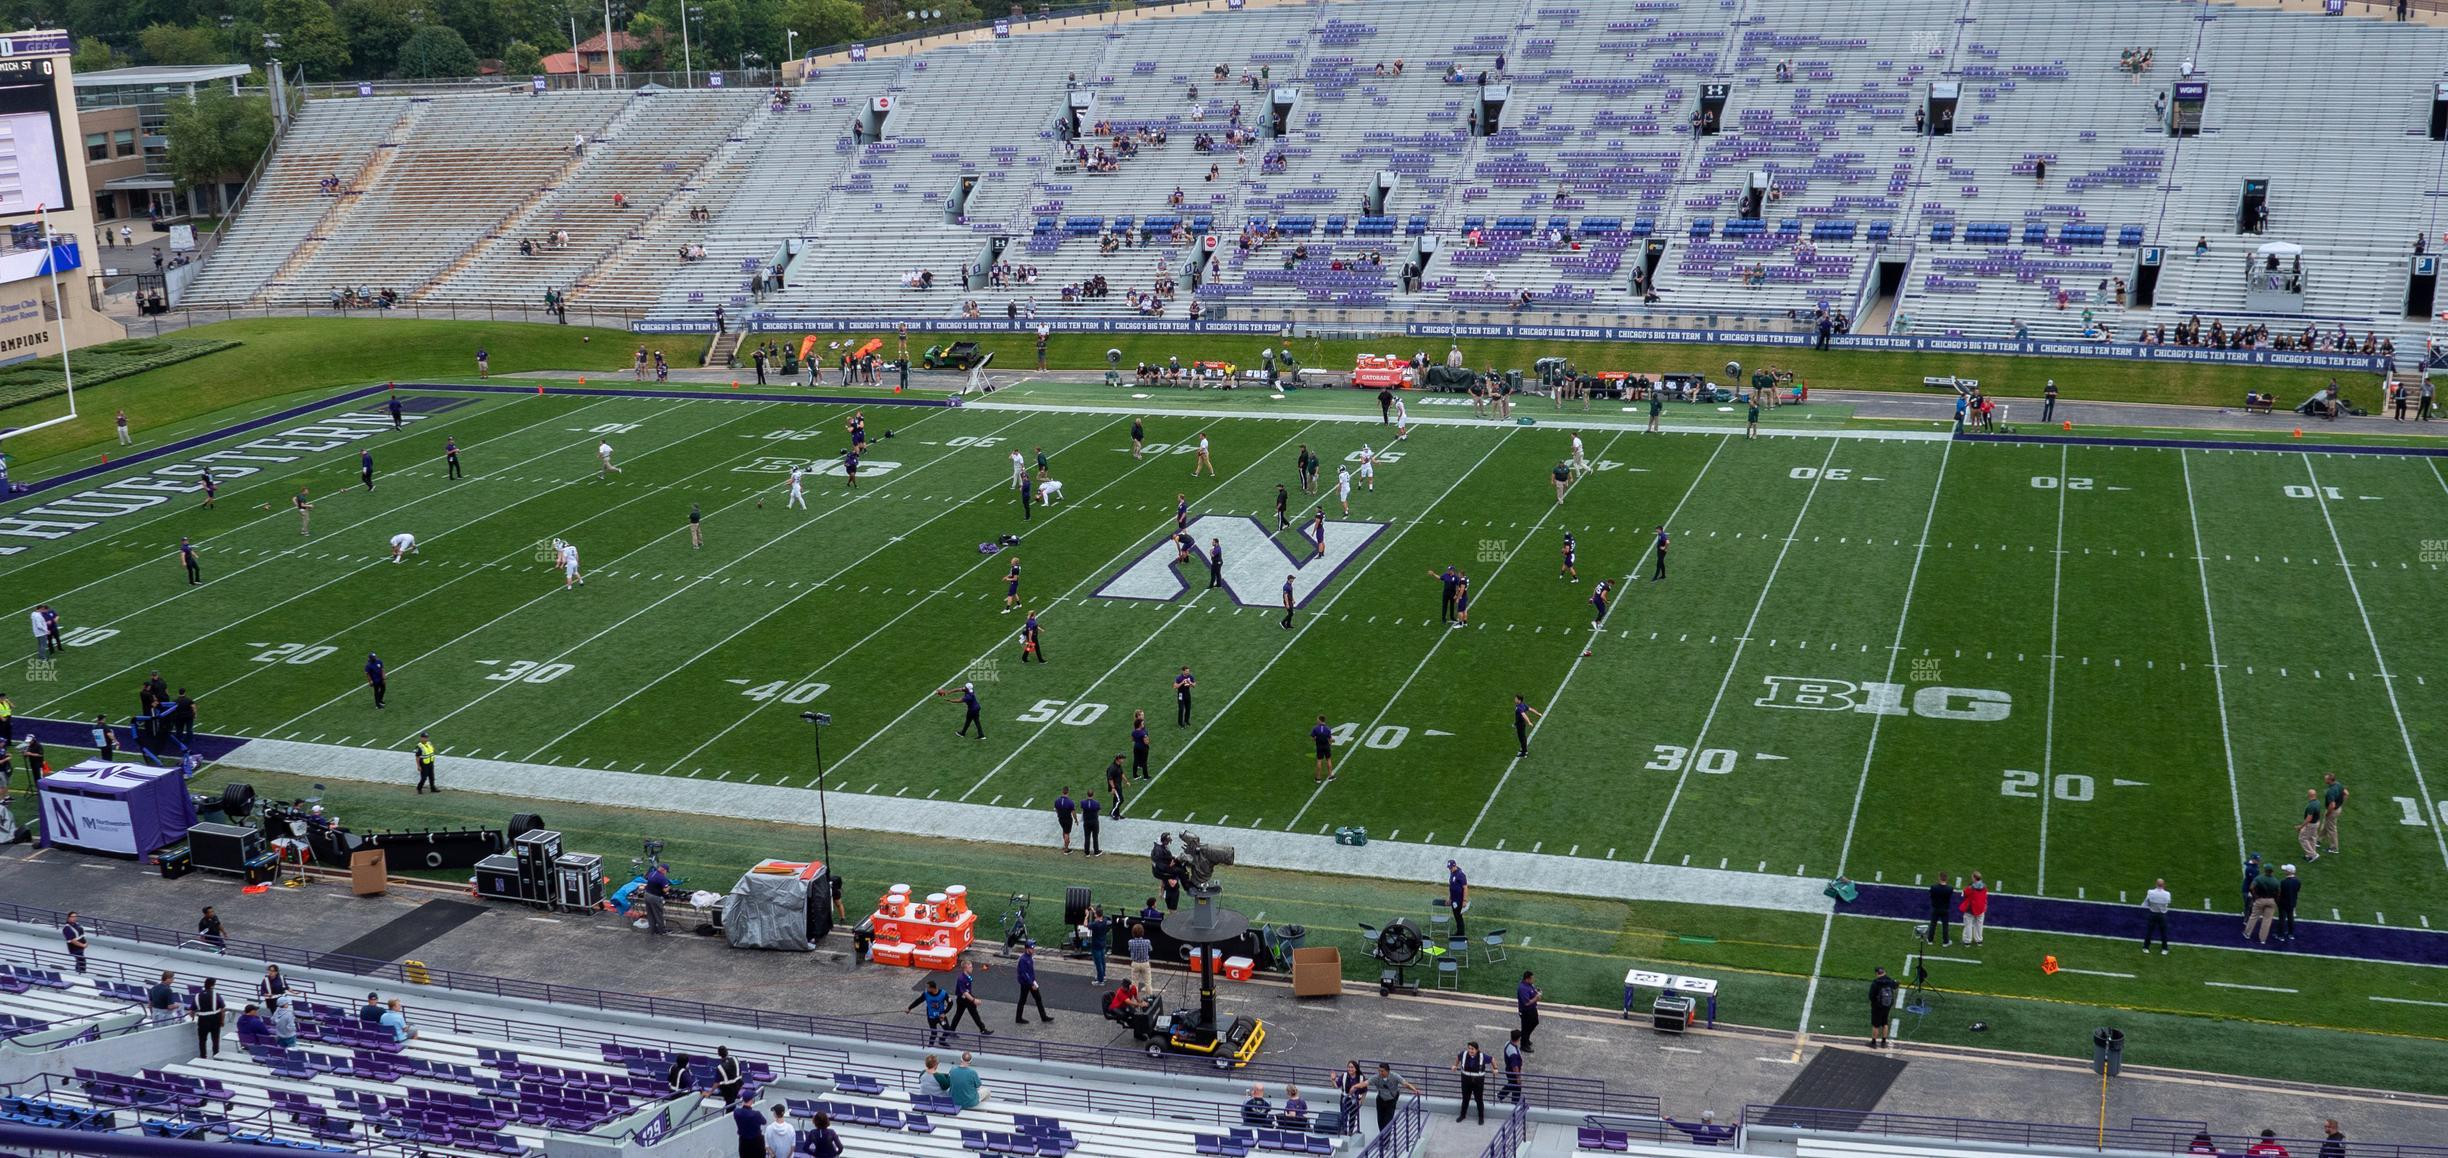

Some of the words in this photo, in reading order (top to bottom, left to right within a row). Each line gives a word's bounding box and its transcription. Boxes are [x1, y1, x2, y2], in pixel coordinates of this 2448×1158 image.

[996, 25, 1008, 34] 105
[852, 49, 864, 57] 104
[21, 61, 32, 70] ST
[43, 61, 53, 75] 0
[534, 81, 545, 89] 102
[710, 77, 721, 85] 103
[751, 321, 757, 330] N
[838, 321, 844, 329] N
[925, 321, 931, 329] N
[1014, 321, 1020, 329] N
[1103, 321, 1110, 329] N
[1194, 322, 1200, 330] N
[1, 331, 49, 352] AMPIONS
[1410, 325, 1416, 333] N
[1467, 326, 1481, 334] TEN
[1506, 326, 1513, 335] N
[1518, 327, 1553, 336] CHICAGO'S
[1553, 328, 1565, 336] BIG
[1565, 328, 1579, 336] TEN
[1580, 329, 1599, 337] TEAM
[1605, 328, 1612, 338] N
[1618, 330, 1653, 338] CHICAGO'S
[1653, 331, 1666, 339] BIG
[1666, 331, 1680, 339] TEN
[1681, 331, 1700, 340] TEAM
[1706, 331, 1713, 340] N
[1719, 332, 1755, 341] CHICAGO'S
[1755, 334, 1768, 342] BIG
[1768, 334, 1783, 342] TEN
[1784, 334, 1803, 343] TEAM
[1810, 335, 1817, 344] N
[1860, 337, 1873, 345] BIG
[1874, 337, 1888, 346] TEN
[1889, 338, 1910, 346] TEAM
[1916, 338, 1924, 348] N
[1930, 339, 1968, 349] CHICAGO'S
[1968, 340, 1982, 349] BIG
[1982, 341, 1997, 350] TEN
[1998, 342, 2019, 351] TEAM
[2026, 342, 2033, 352] N
[2040, 343, 2079, 353] CHICAGO'S
[2079, 345, 2093, 354] BIG
[2094, 346, 2109, 354] TEN
[2110, 346, 2132, 355] TEAM
[2139, 347, 2146, 357] N
[2153, 348, 2194, 358] CHICAGO'S
[2194, 350, 2208, 359] BIG
[2208, 350, 2225, 359] TEN
[2226, 351, 2248, 360] TEAM
[2255, 352, 2263, 361] N
[2270, 353, 2312, 363] CHICAGO'S
[2312, 355, 2327, 364] BIG
[2327, 356, 2344, 365] TEN
[2345, 357, 2368, 366] TEAM
[2376, 358, 2384, 367] N
[762, 430, 823, 440] 20
[946, 436, 1008, 447] 30
[1789, 467, 1852, 480] 30
[0, 411, 429, 557] HWESTERN
[2031, 476, 2094, 490] 20
[2283, 485, 2344, 499] 10
[250, 643, 338, 664] 20
[486, 660, 576, 683] 30
[742, 680, 832, 703] 40
[1016, 699, 1109, 726] 50
[1330, 722, 1410, 749] 40
[1642, 745, 1738, 774] 30
[1998, 769, 2093, 801] 20
[52, 797, 80, 840] N
[1230, 968, 1239, 978] G
